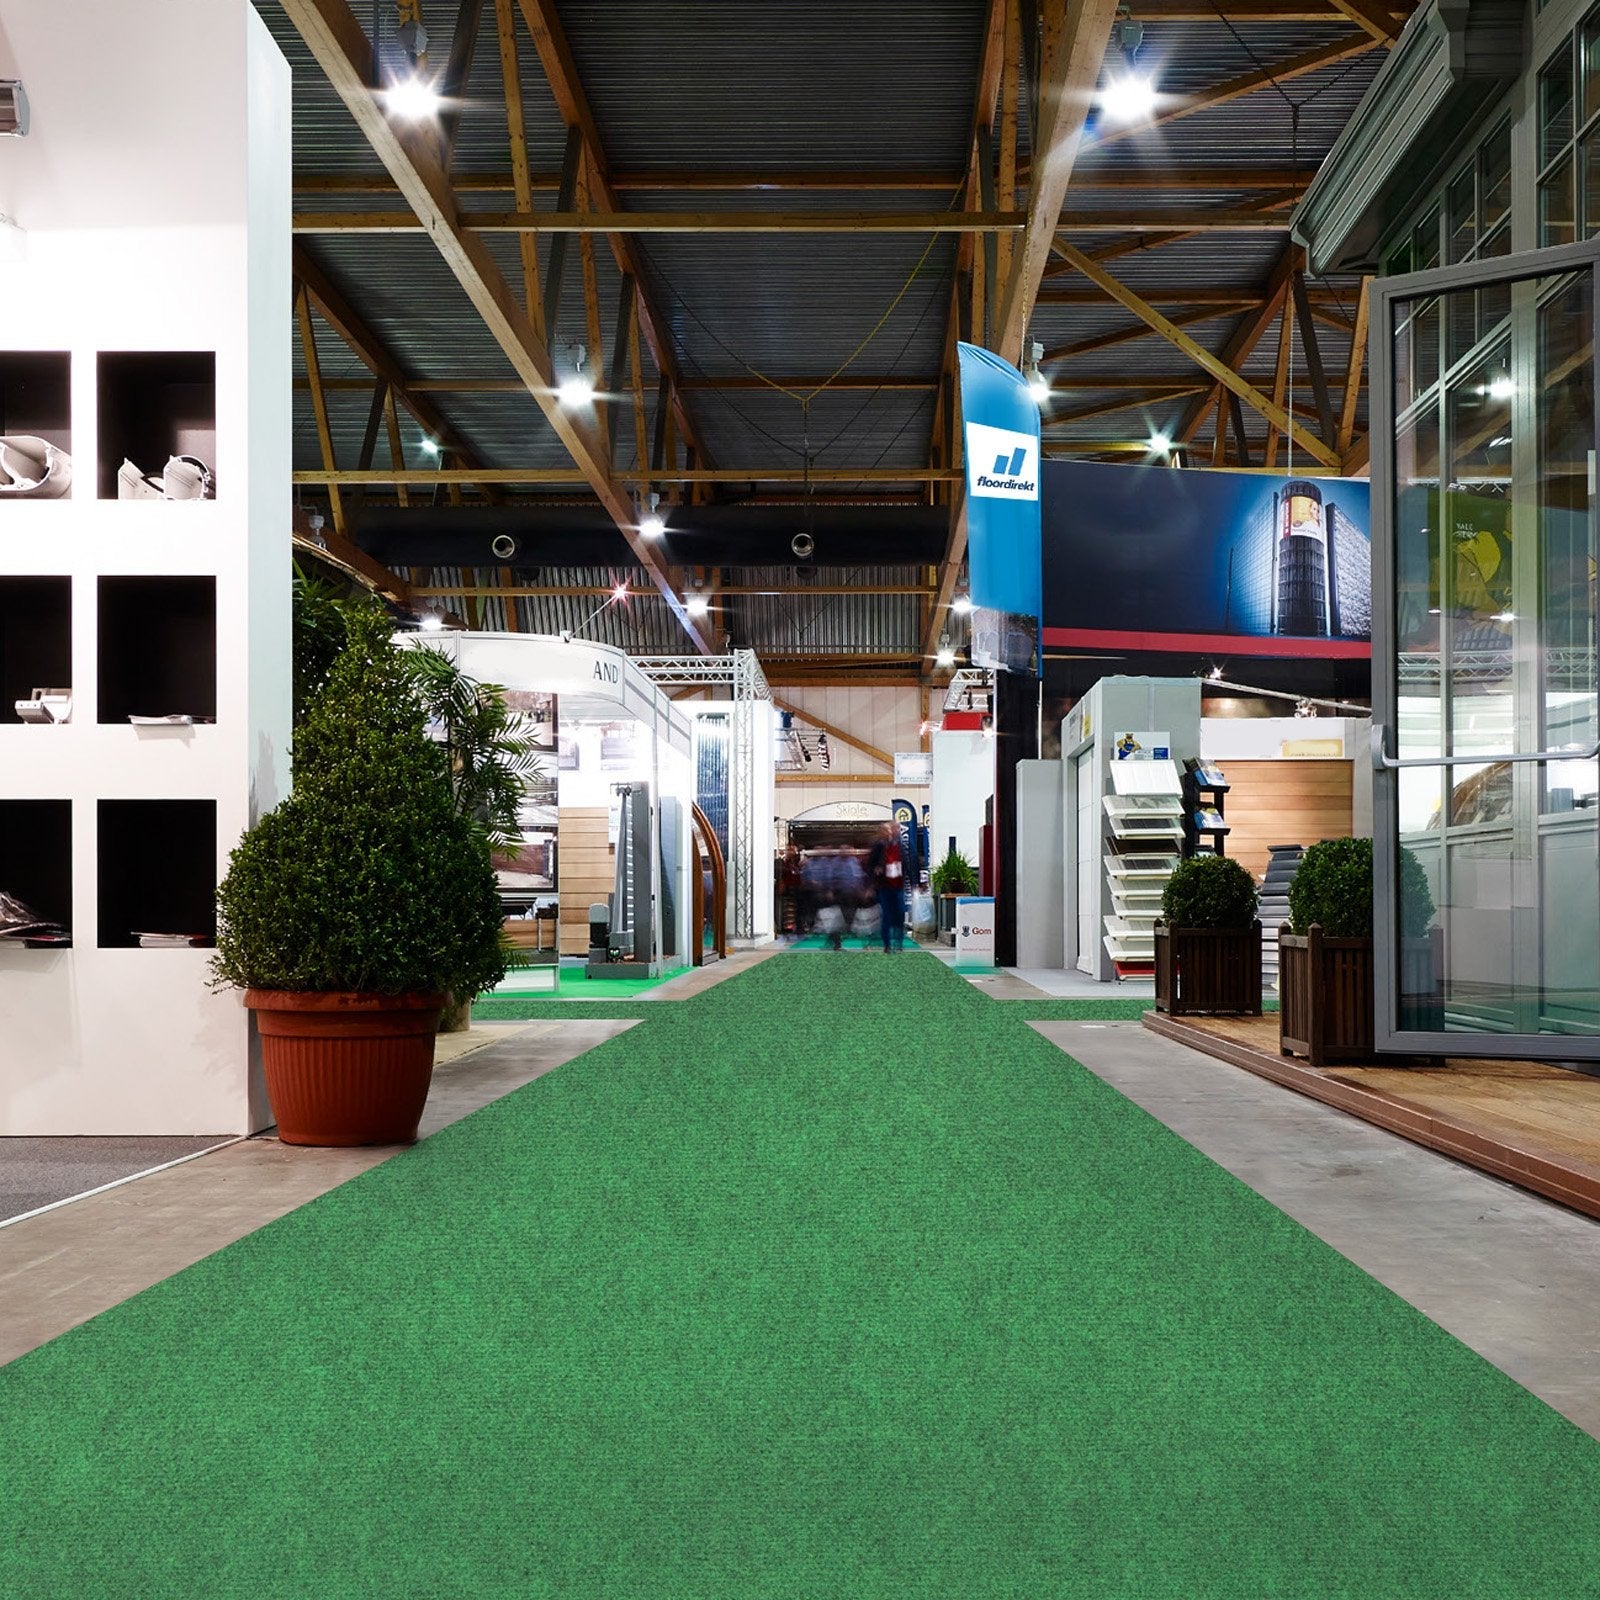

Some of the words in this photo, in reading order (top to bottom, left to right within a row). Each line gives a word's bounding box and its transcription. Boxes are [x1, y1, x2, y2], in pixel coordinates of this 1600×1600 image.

[977, 475, 1034, 491] floordirekt
[593, 660, 618, 683] AND
[972, 926, 992, 935] Gom
